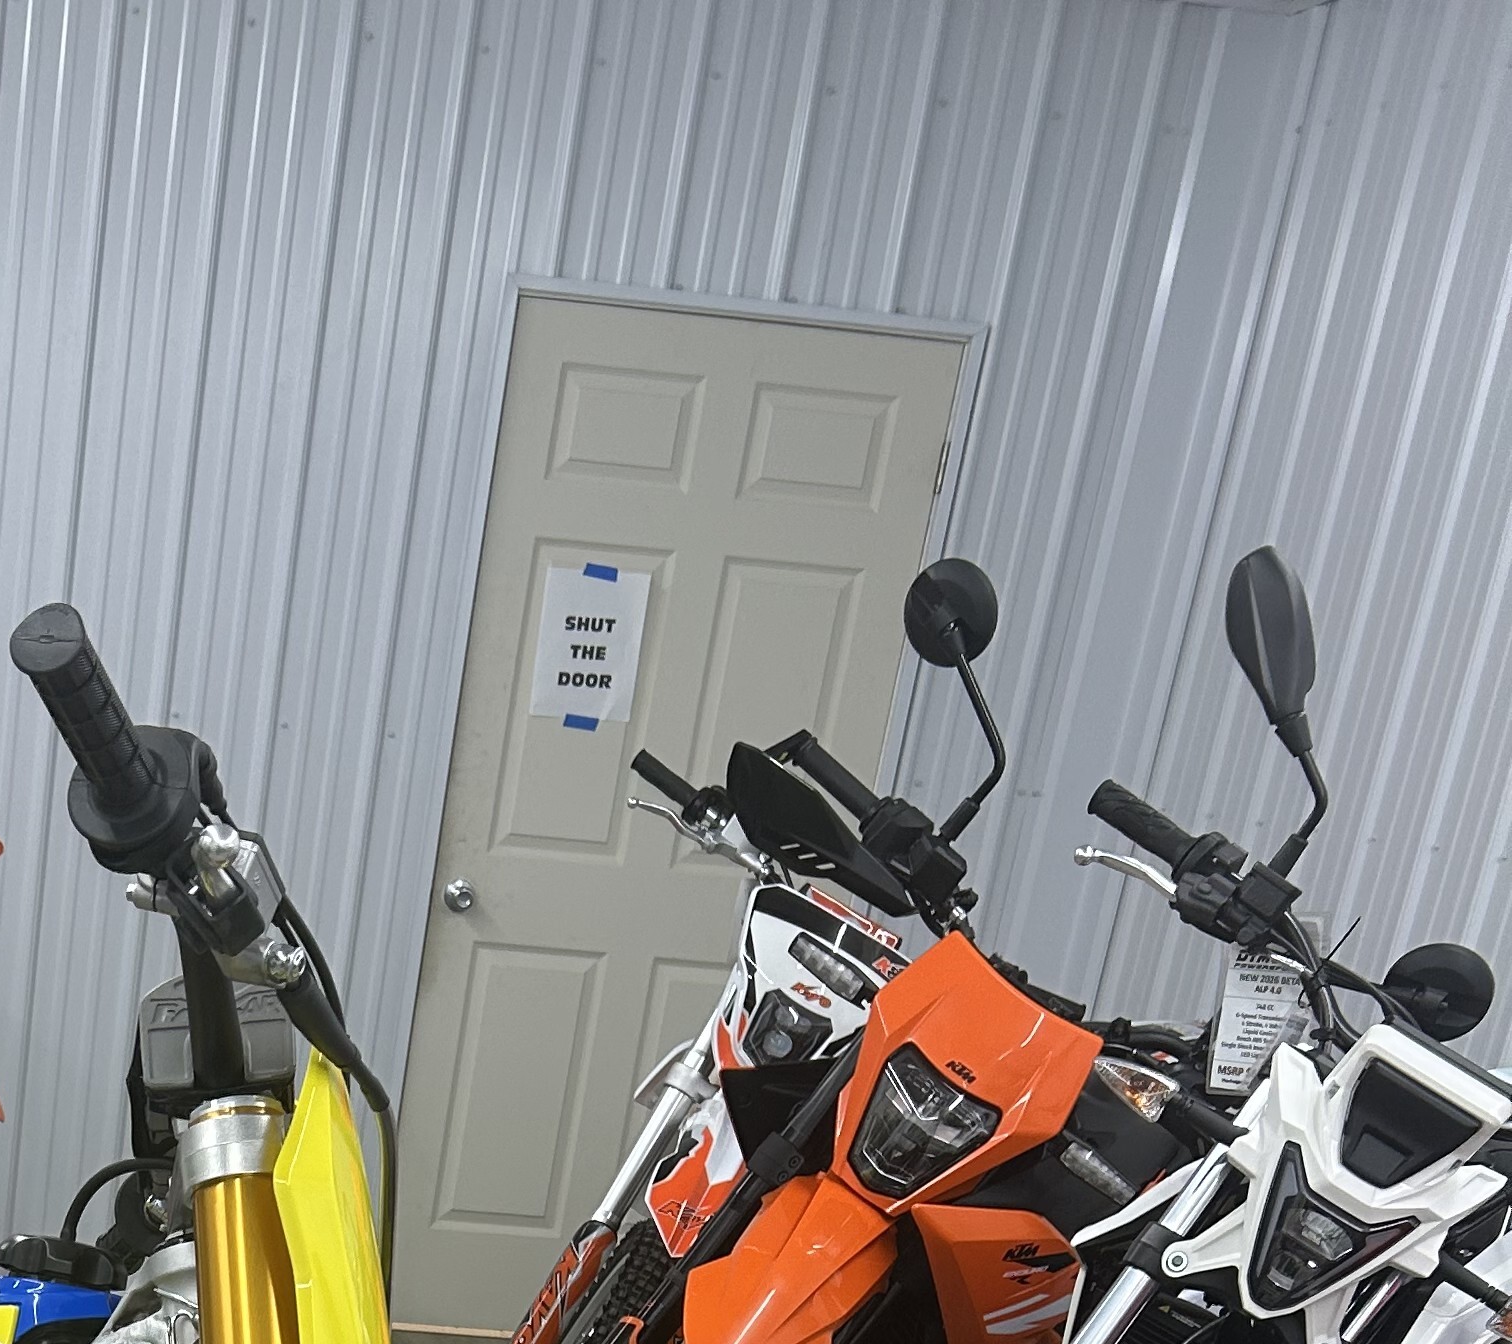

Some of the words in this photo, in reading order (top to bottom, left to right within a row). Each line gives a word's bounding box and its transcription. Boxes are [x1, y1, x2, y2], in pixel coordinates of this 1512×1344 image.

[565, 615, 616, 633] SHUT
[570, 644, 606, 661] THE
[557, 671, 612, 689] DOOR
[1239, 974, 1259, 983] NEW
[944, 1059, 977, 1085] KTM
